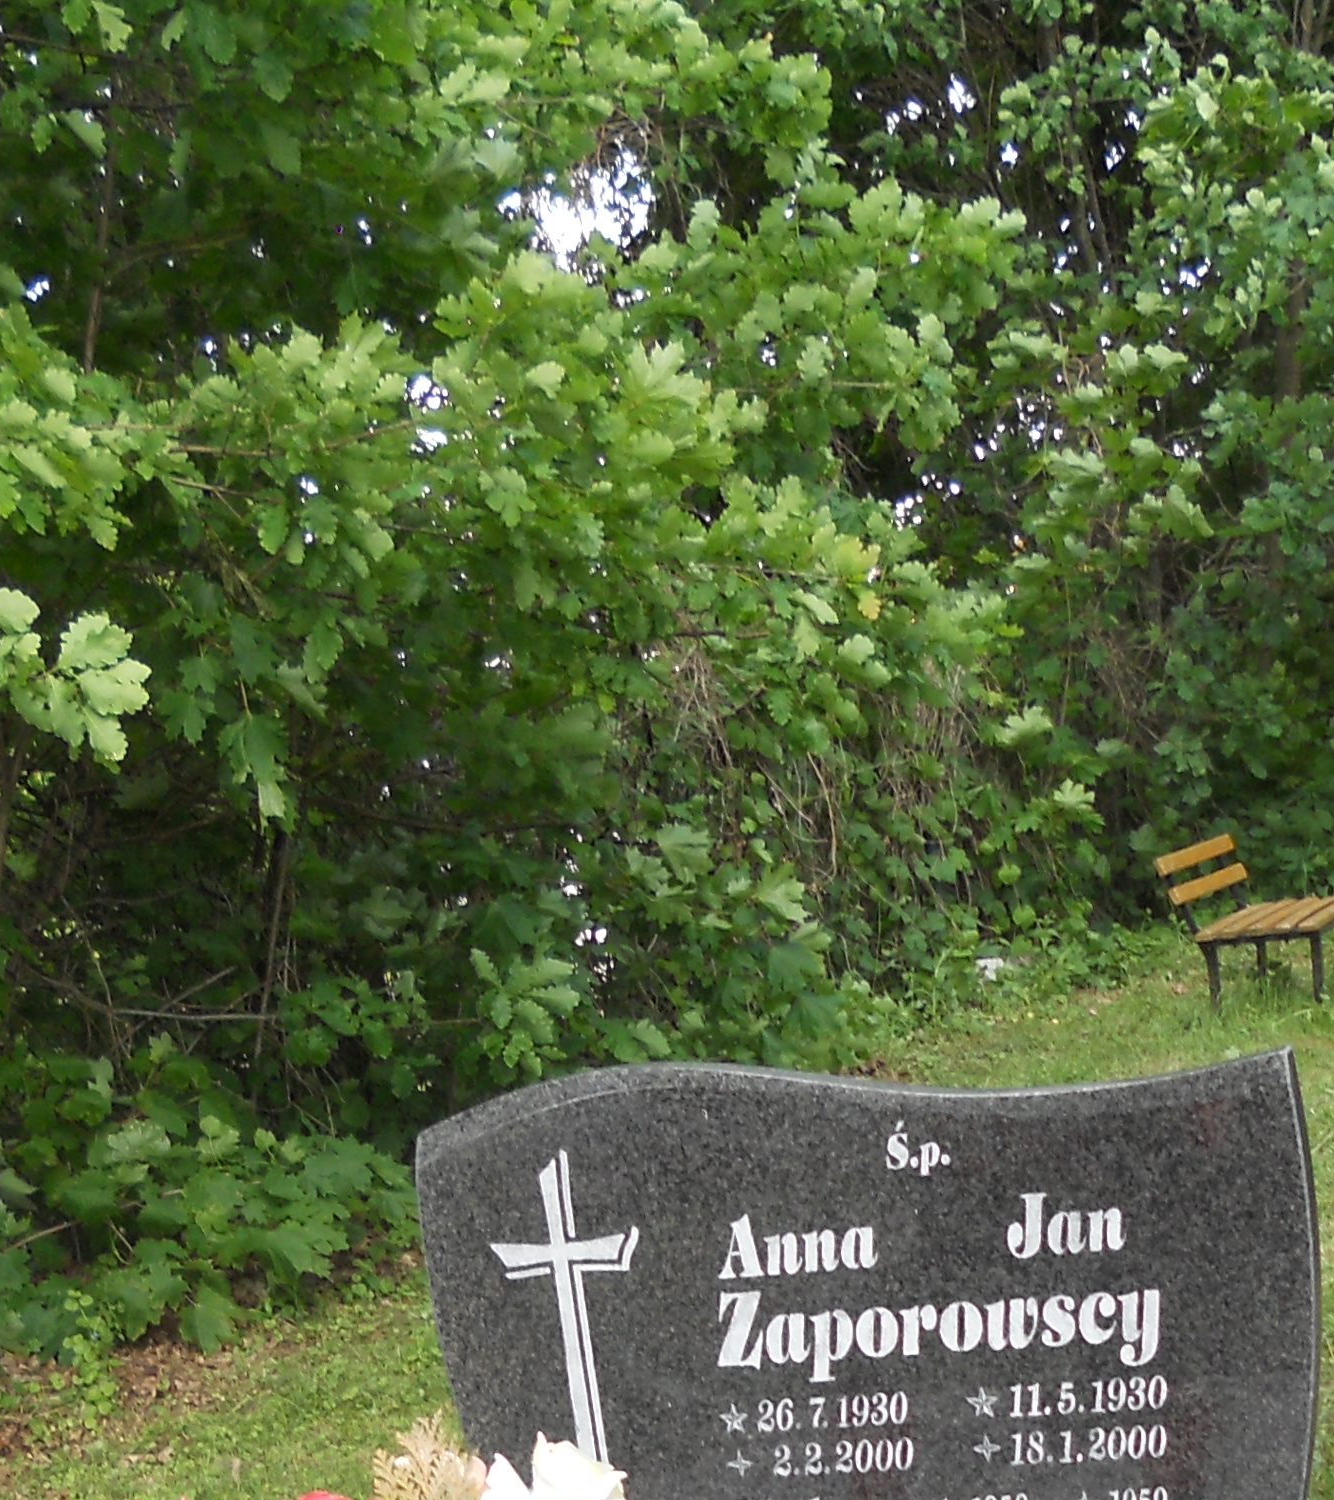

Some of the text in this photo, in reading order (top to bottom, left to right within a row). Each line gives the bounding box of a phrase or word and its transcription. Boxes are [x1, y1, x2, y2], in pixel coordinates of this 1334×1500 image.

[717, 1192, 1126, 1280] Anna Jan
[717, 1289, 1161, 1383] Zaporowscy
